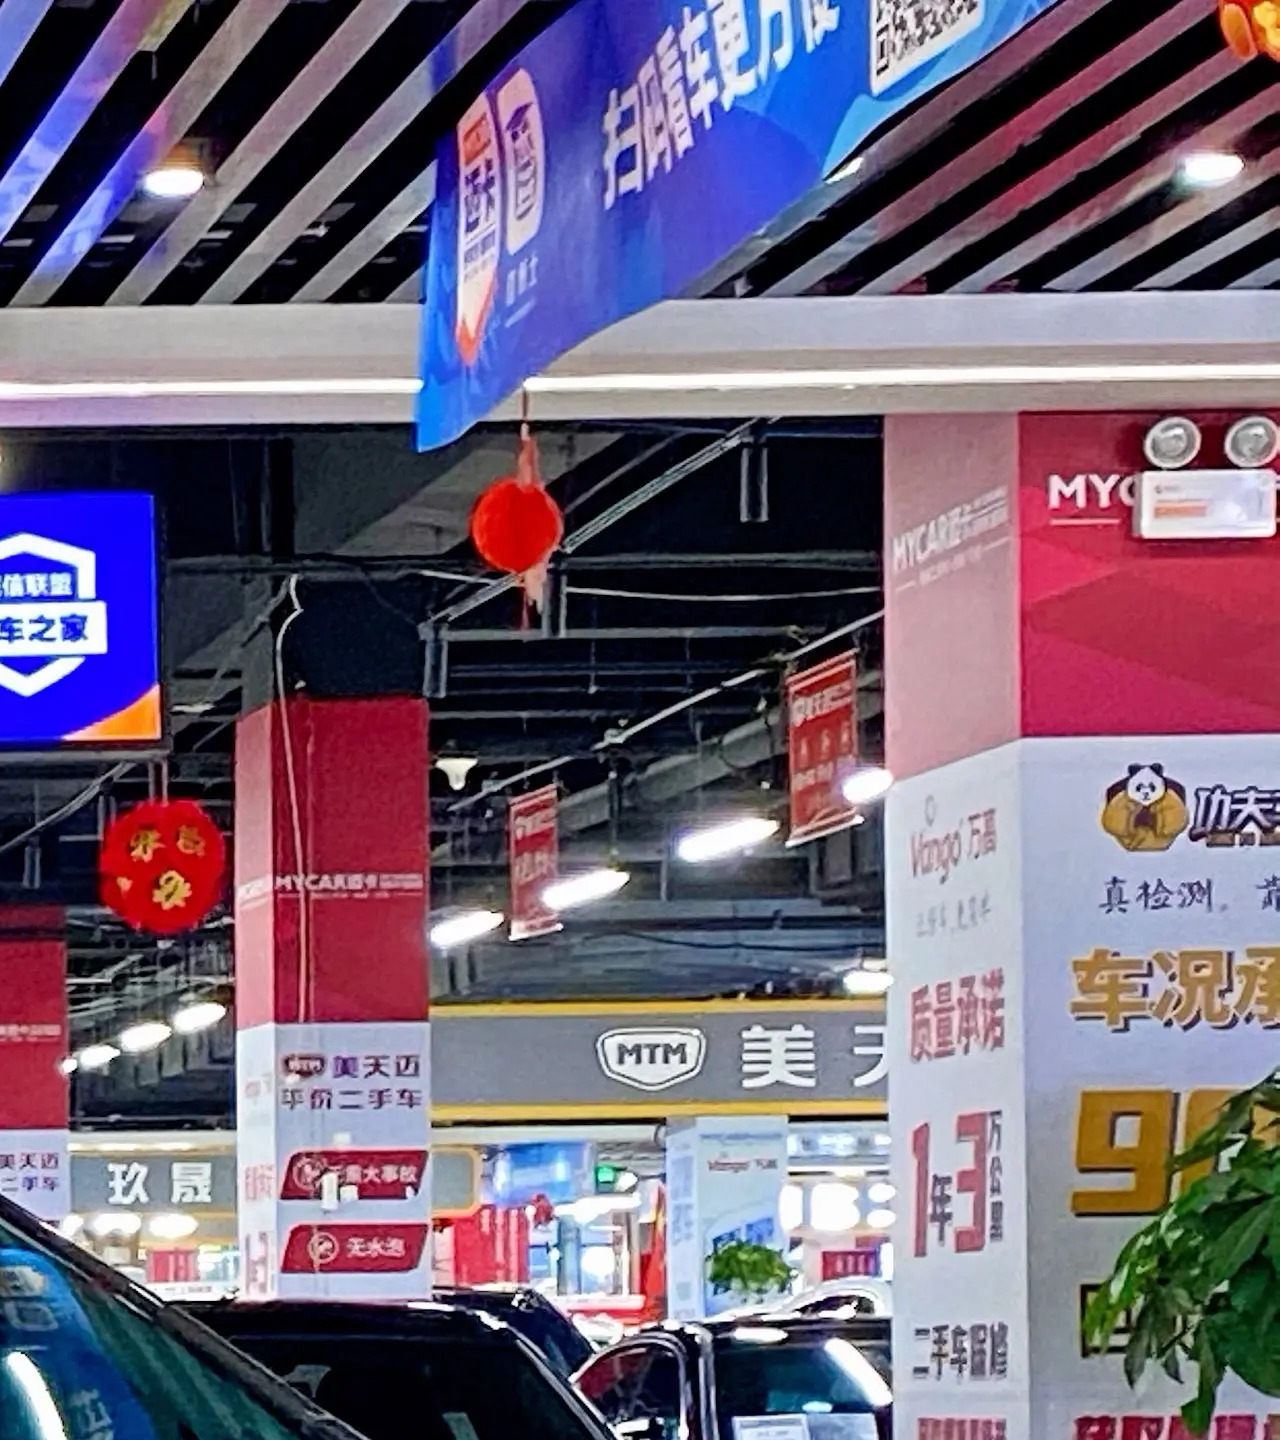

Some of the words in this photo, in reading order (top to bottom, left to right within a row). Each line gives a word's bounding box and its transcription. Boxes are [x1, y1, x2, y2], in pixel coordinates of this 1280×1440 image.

[1189, 784, 1280, 842] 功夫
[616, 1042, 688, 1067] MTM
[332, 1055, 421, 1080] 美天迈
